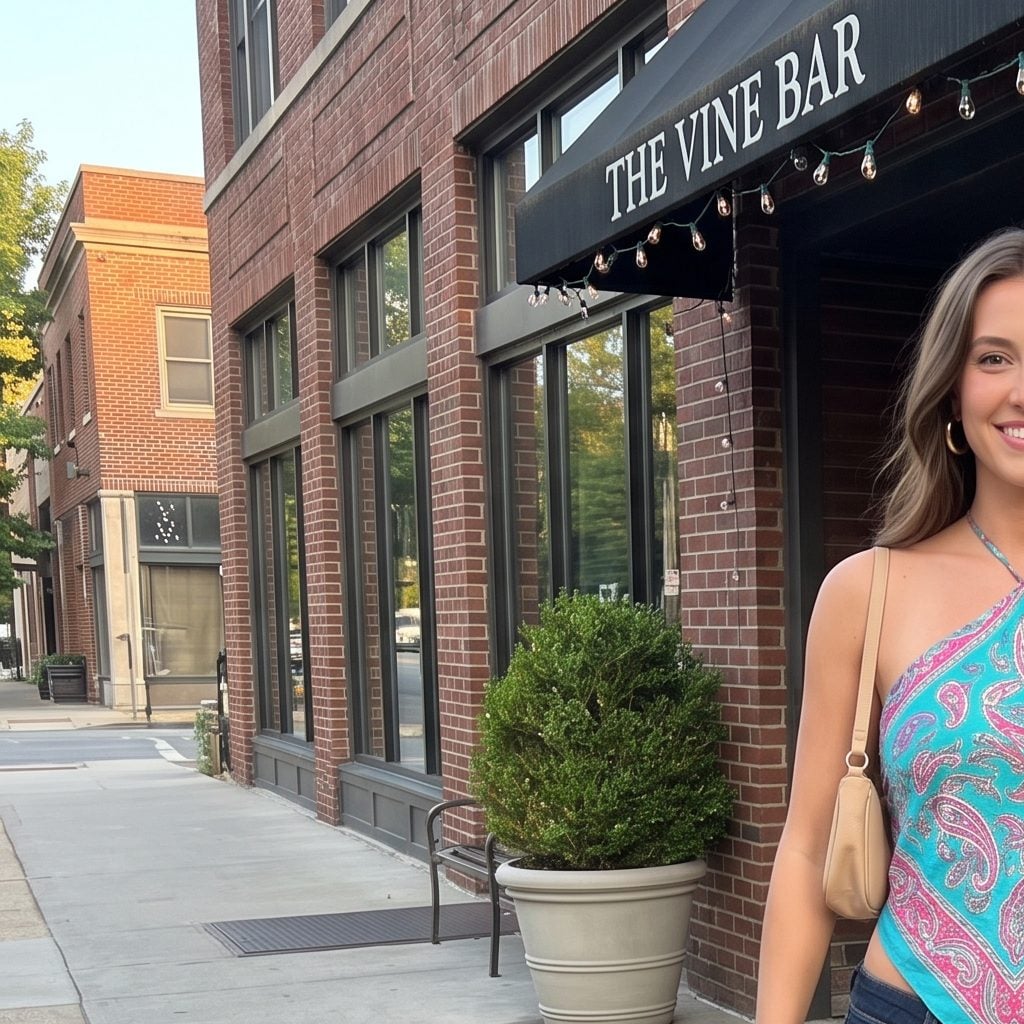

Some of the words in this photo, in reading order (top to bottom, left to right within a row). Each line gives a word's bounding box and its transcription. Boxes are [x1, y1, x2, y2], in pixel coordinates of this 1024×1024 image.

[605, 131, 668, 222] THE
[674, 70, 764, 182] VINE
[774, 14, 866, 131] BAR
